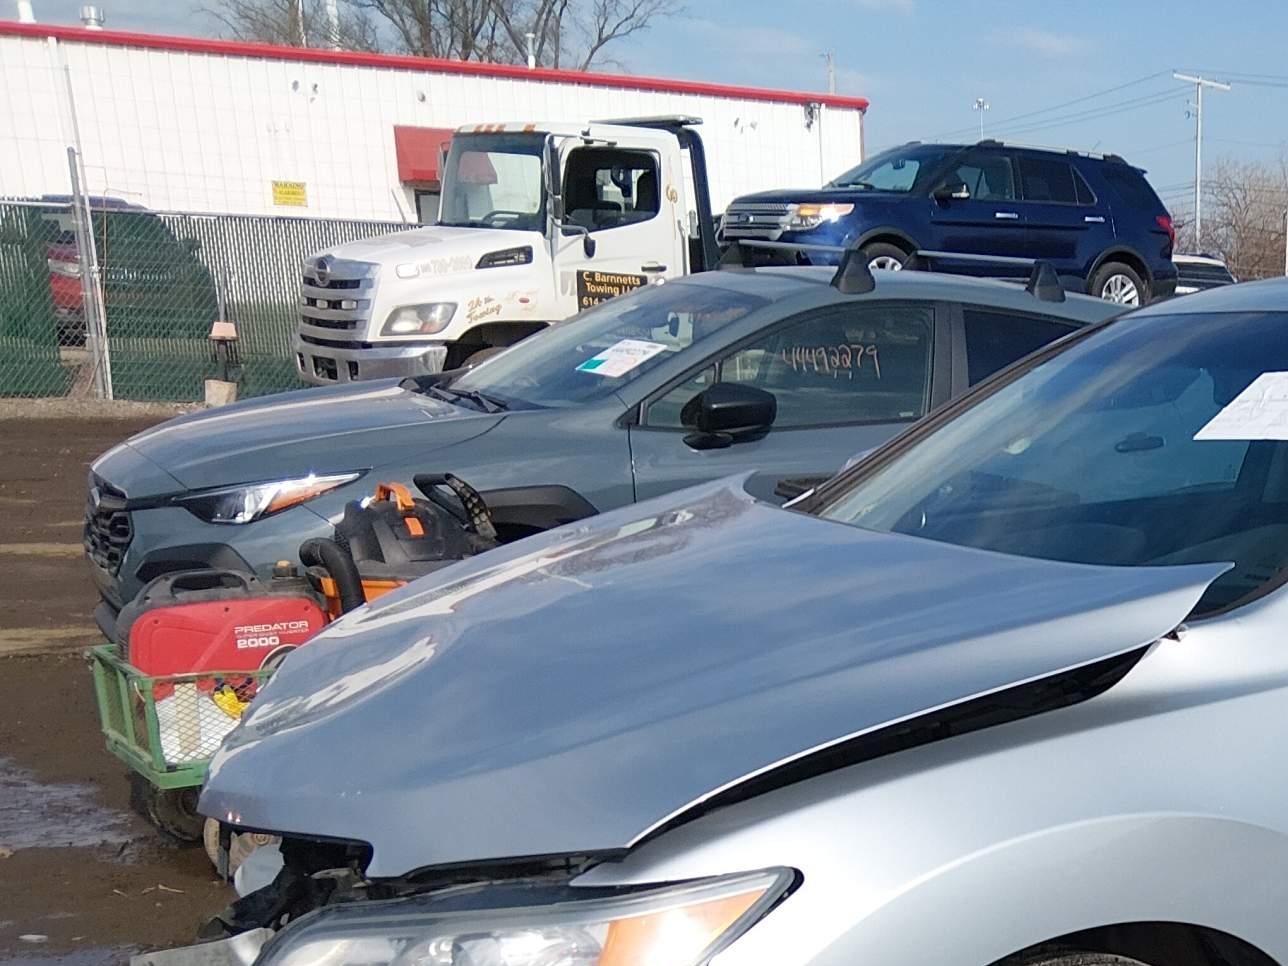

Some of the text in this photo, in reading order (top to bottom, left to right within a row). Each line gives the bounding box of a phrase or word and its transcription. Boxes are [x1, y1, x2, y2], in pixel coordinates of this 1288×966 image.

[594, 272, 641, 285] Barnnetts
[586, 282, 620, 297] Towing
[782, 344, 881, 379] 44492279
[234, 620, 309, 635] PREDATOR
[237, 636, 280, 649] 2000
